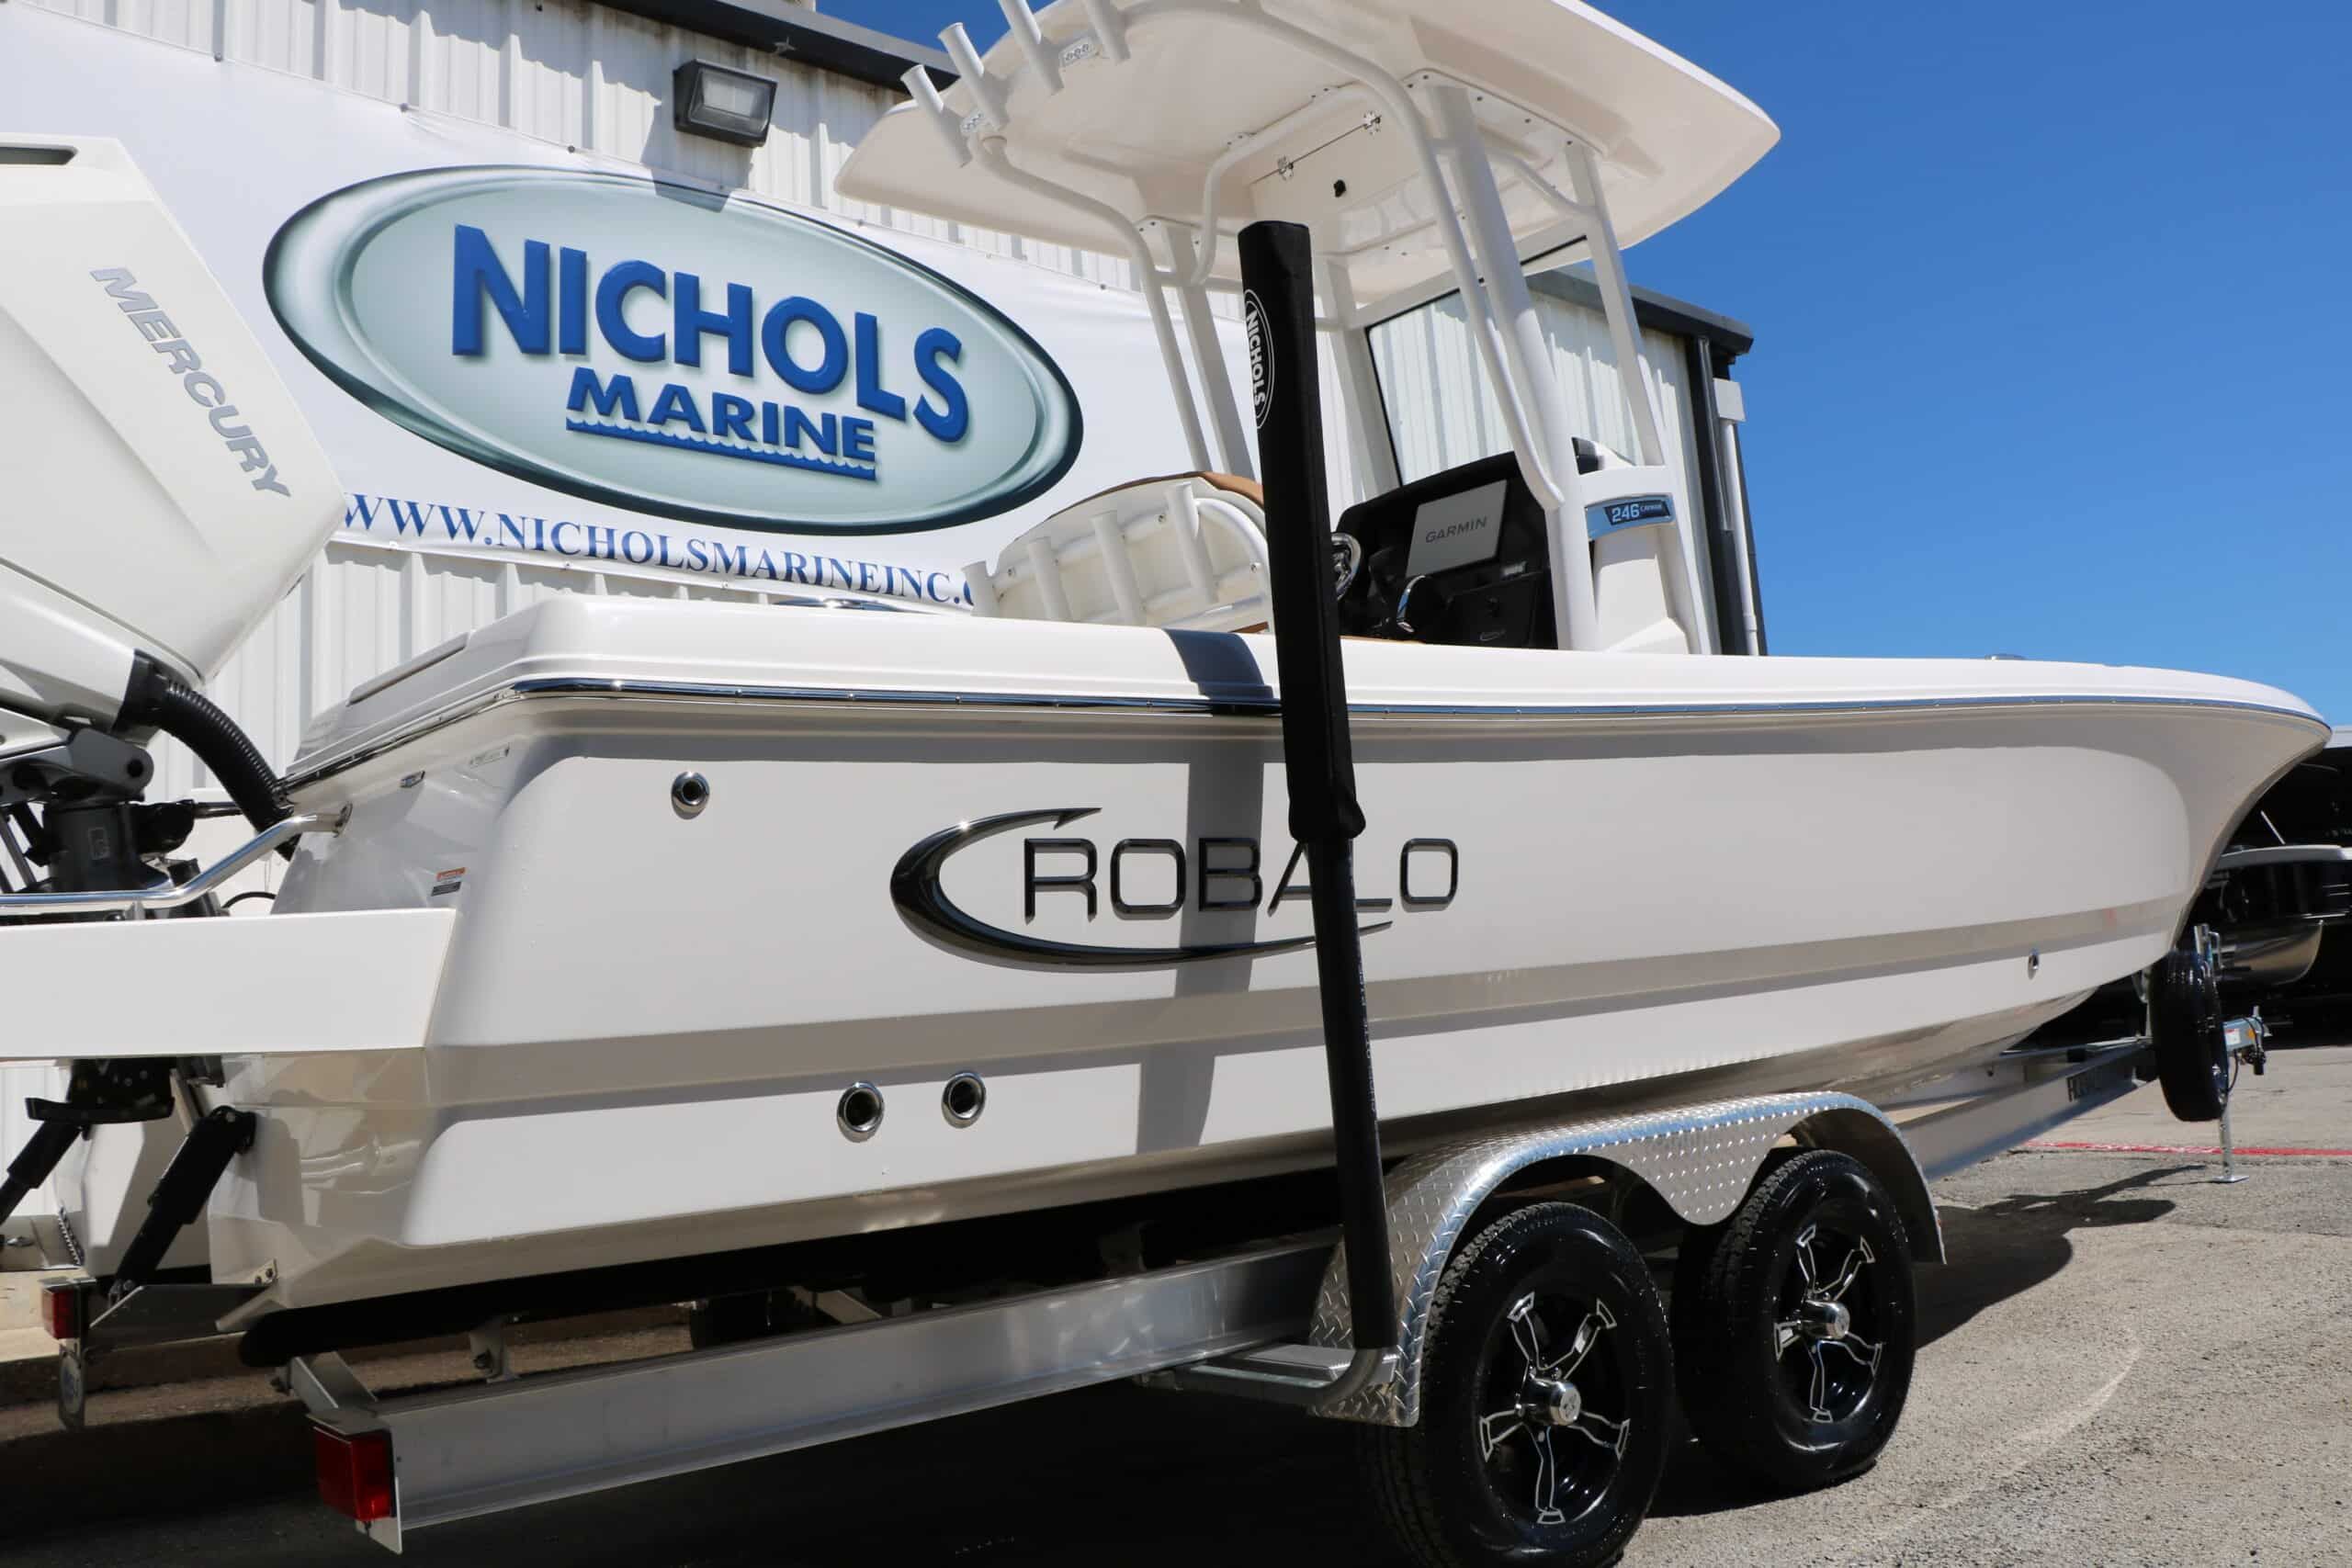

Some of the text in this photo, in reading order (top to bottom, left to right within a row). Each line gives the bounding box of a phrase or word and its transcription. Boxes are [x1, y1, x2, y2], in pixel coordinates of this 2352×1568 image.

[452, 223, 968, 443] NICHOLS
[1246, 309, 1266, 406] NICHOLS
[90, 266, 291, 497] MERCURY
[567, 367, 876, 462] MARINE
[1425, 515, 1487, 544] GARMIN
[1611, 503, 1640, 523] 246
